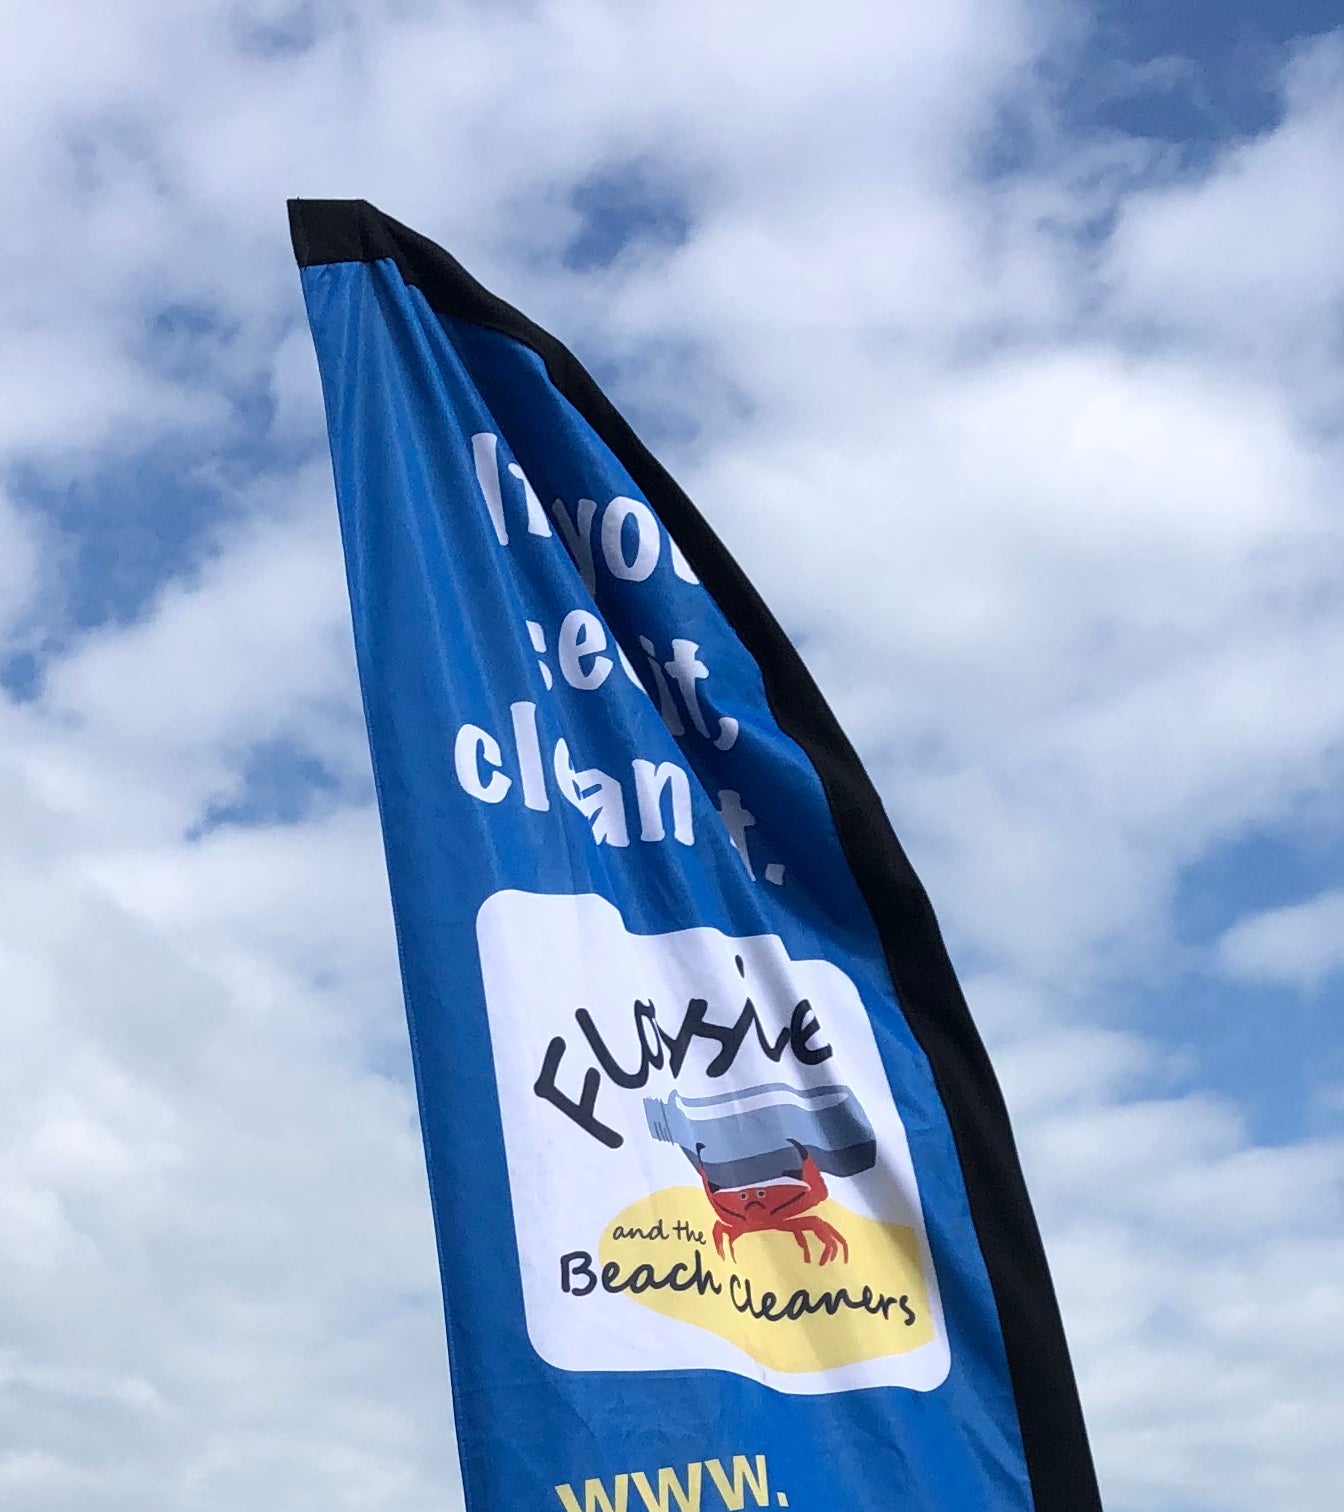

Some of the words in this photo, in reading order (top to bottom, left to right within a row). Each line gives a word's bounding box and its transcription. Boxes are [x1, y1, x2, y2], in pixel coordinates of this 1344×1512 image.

[552, 496, 700, 600] yo
[612, 1219, 670, 1241] and
[672, 1220, 707, 1245] the
[560, 1250, 722, 1297] Beach
[729, 1274, 916, 1326] Cleaners
